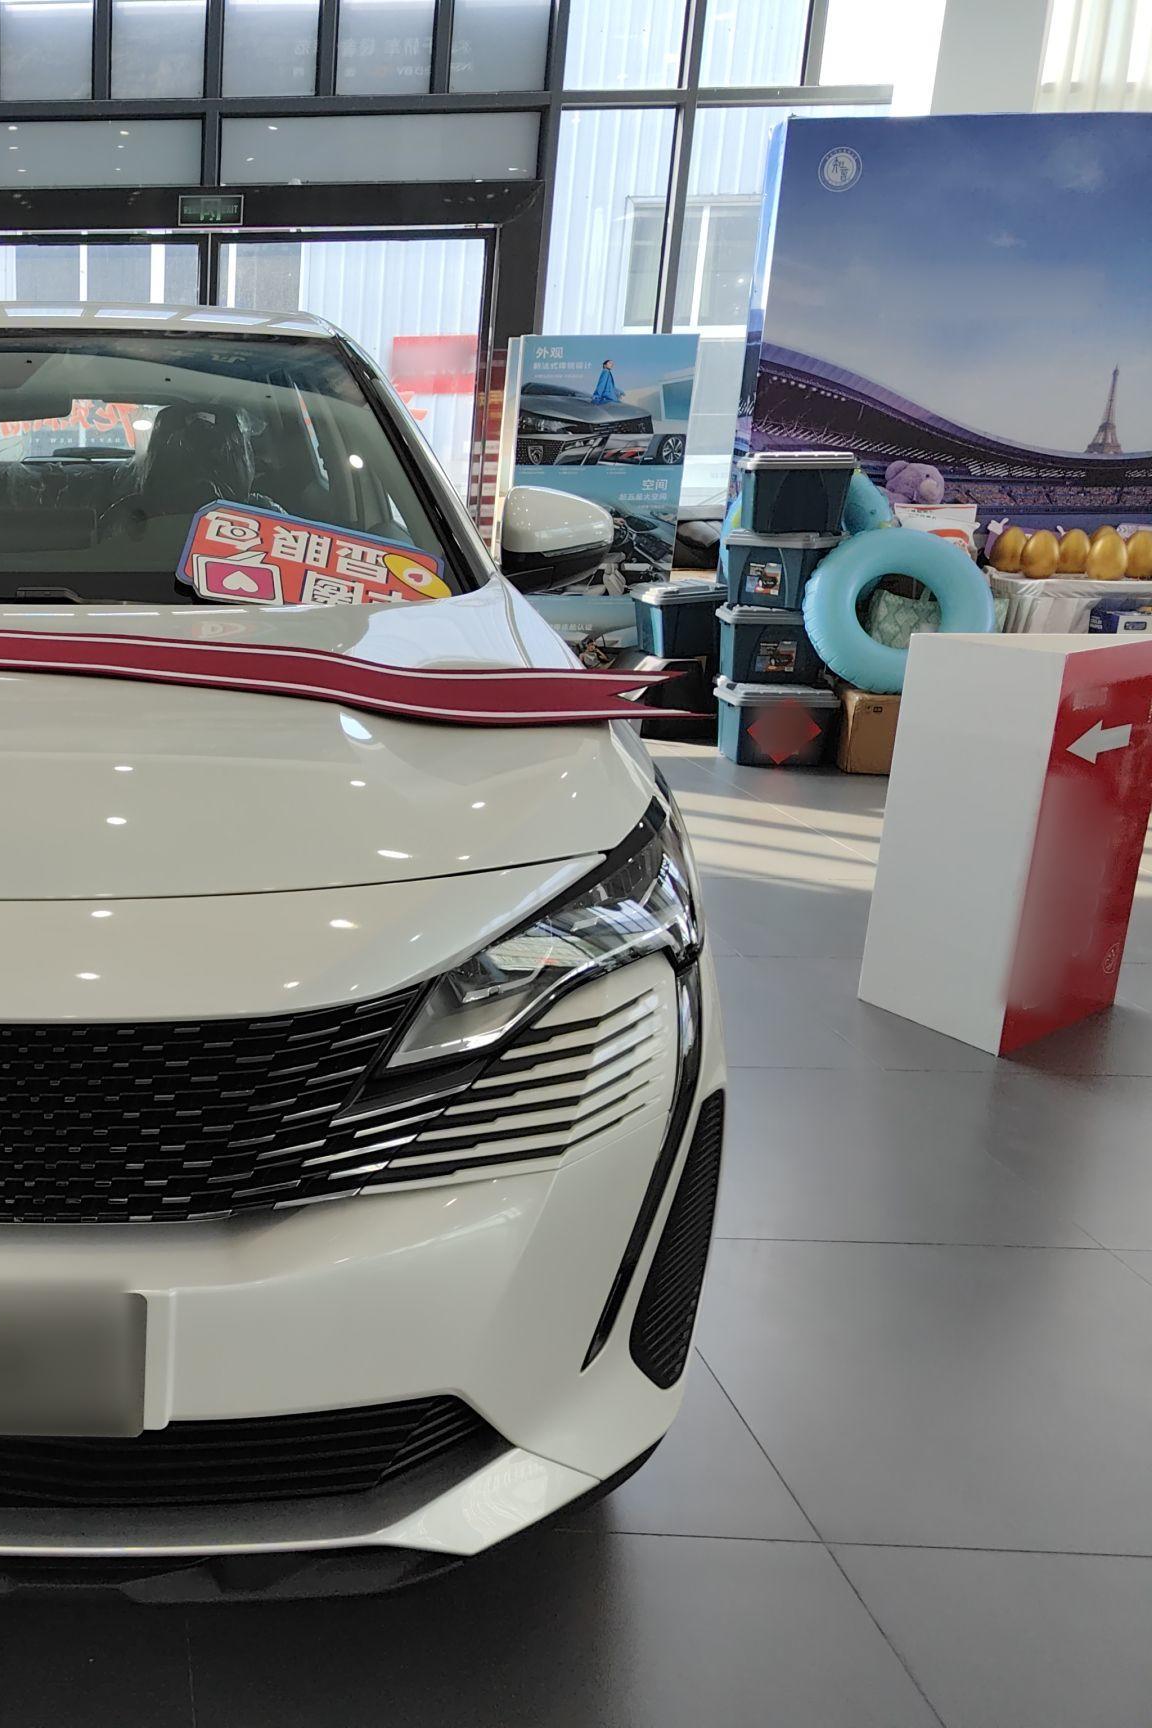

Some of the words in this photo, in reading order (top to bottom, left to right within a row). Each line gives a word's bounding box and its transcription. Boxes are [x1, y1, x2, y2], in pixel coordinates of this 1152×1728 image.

[535, 346, 564, 359] 外观
[641, 478, 668, 491] 空间
[205, 510, 389, 585] 显眼包
